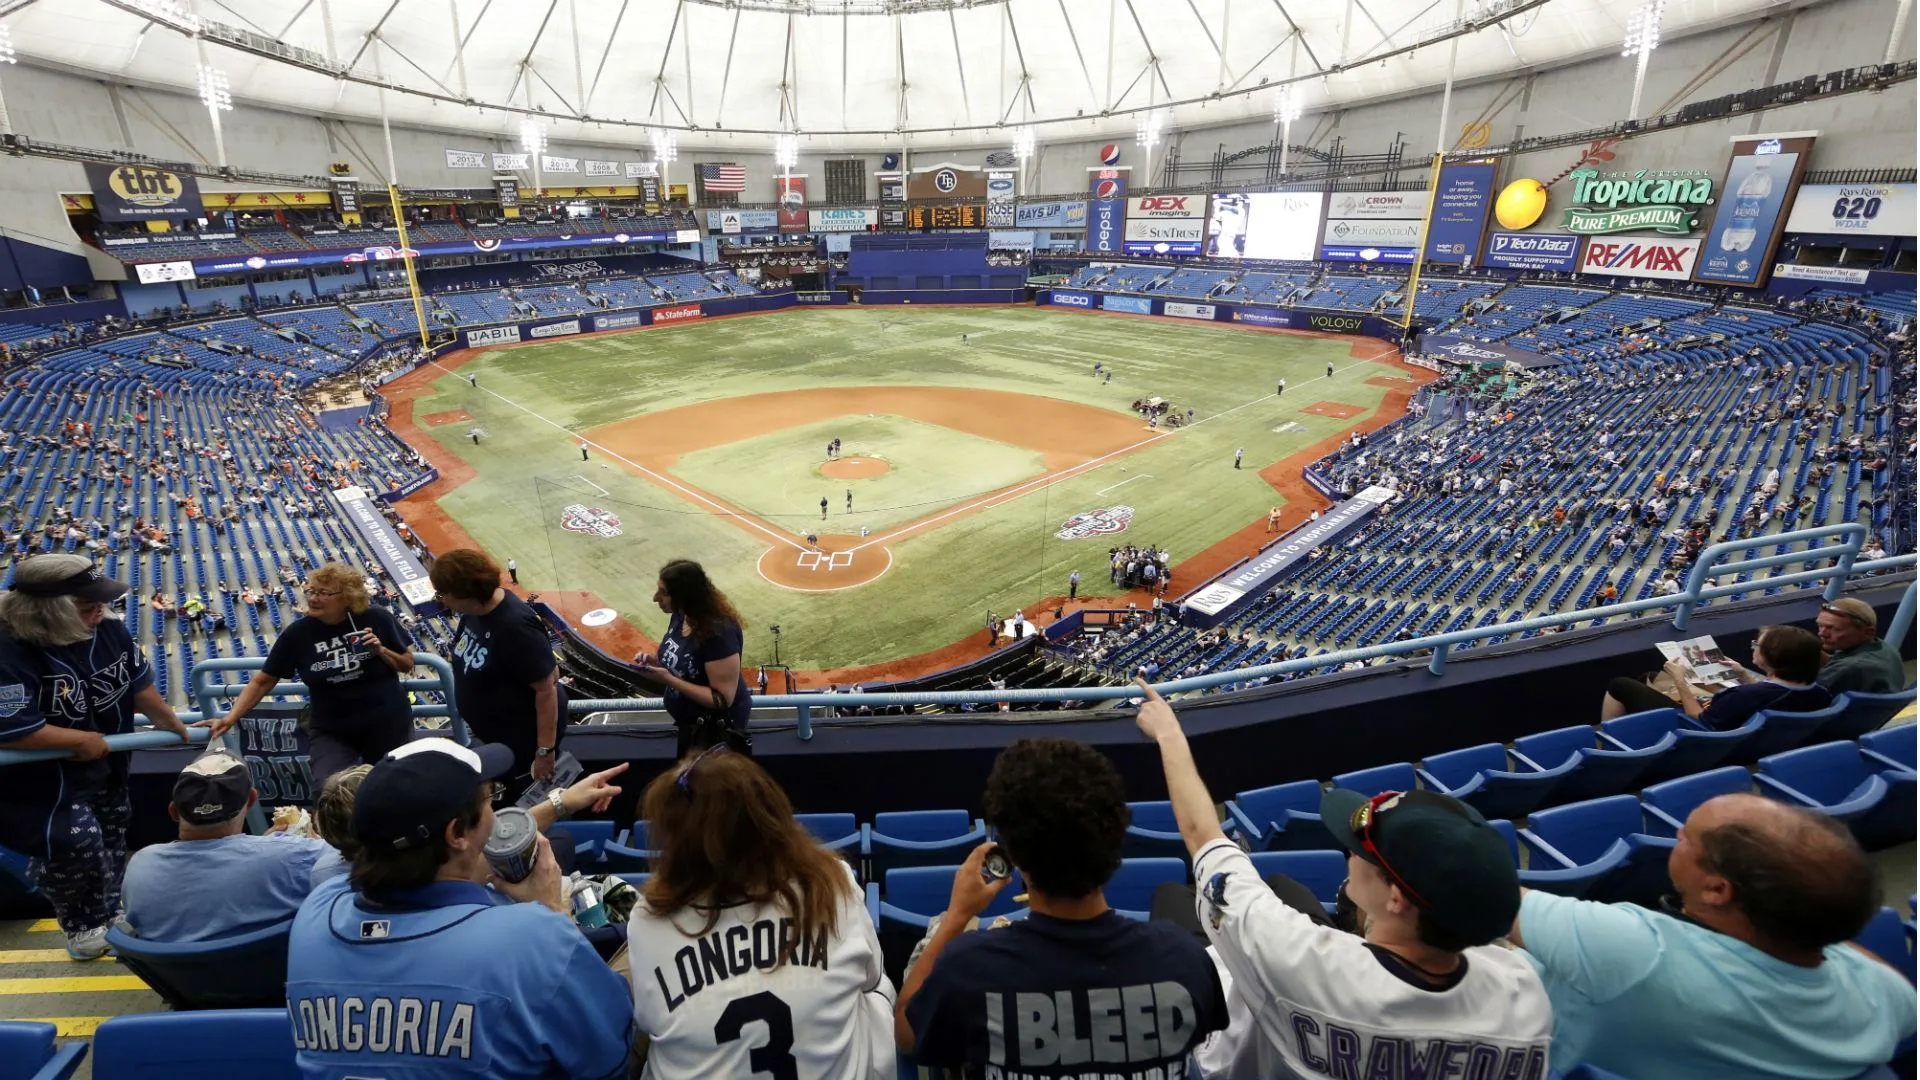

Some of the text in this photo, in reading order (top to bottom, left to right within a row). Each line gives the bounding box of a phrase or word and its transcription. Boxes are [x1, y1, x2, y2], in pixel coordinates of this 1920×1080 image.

[117, 166, 174, 195] tbt
[1569, 168, 1713, 208] Tropicana
[1442, 193, 1468, 201] keeping
[1861, 188, 1889, 197] RADIO
[987, 203, 1013, 215] ROSE
[1019, 207, 1044, 220] RAYS
[1046, 205, 1061, 217] UP
[1139, 196, 1189, 211] DEX
[1832, 197, 1882, 219] 620
[1099, 205, 1113, 251] pepsi
[1570, 210, 1682, 230] PURE PREMIUM
[1835, 220, 1869, 229] WDAE
[1510, 238, 1569, 251] Tech Data
[1523, 257, 1565, 265] SUPPORTING
[1586, 243, 1690, 272] RE/MAX
[1806, 267, 1837, 275] Assistance?
[1053, 294, 1089, 305] GEICO
[1310, 315, 1362, 329] VOLOGY
[469, 327, 518, 342] JABIL
[1231, 500, 1370, 587] WELCOME TO TROPICANA FIELD
[394, 559, 418, 580] FIELD
[1192, 588, 1231, 608] RAYS
[240, 718, 298, 752] THE
[654, 917, 829, 1013] LONGORIA
[287, 996, 475, 1060] LONGORIA
[985, 980, 1198, 1066] I BLEED
[714, 990, 799, 1080] 3
